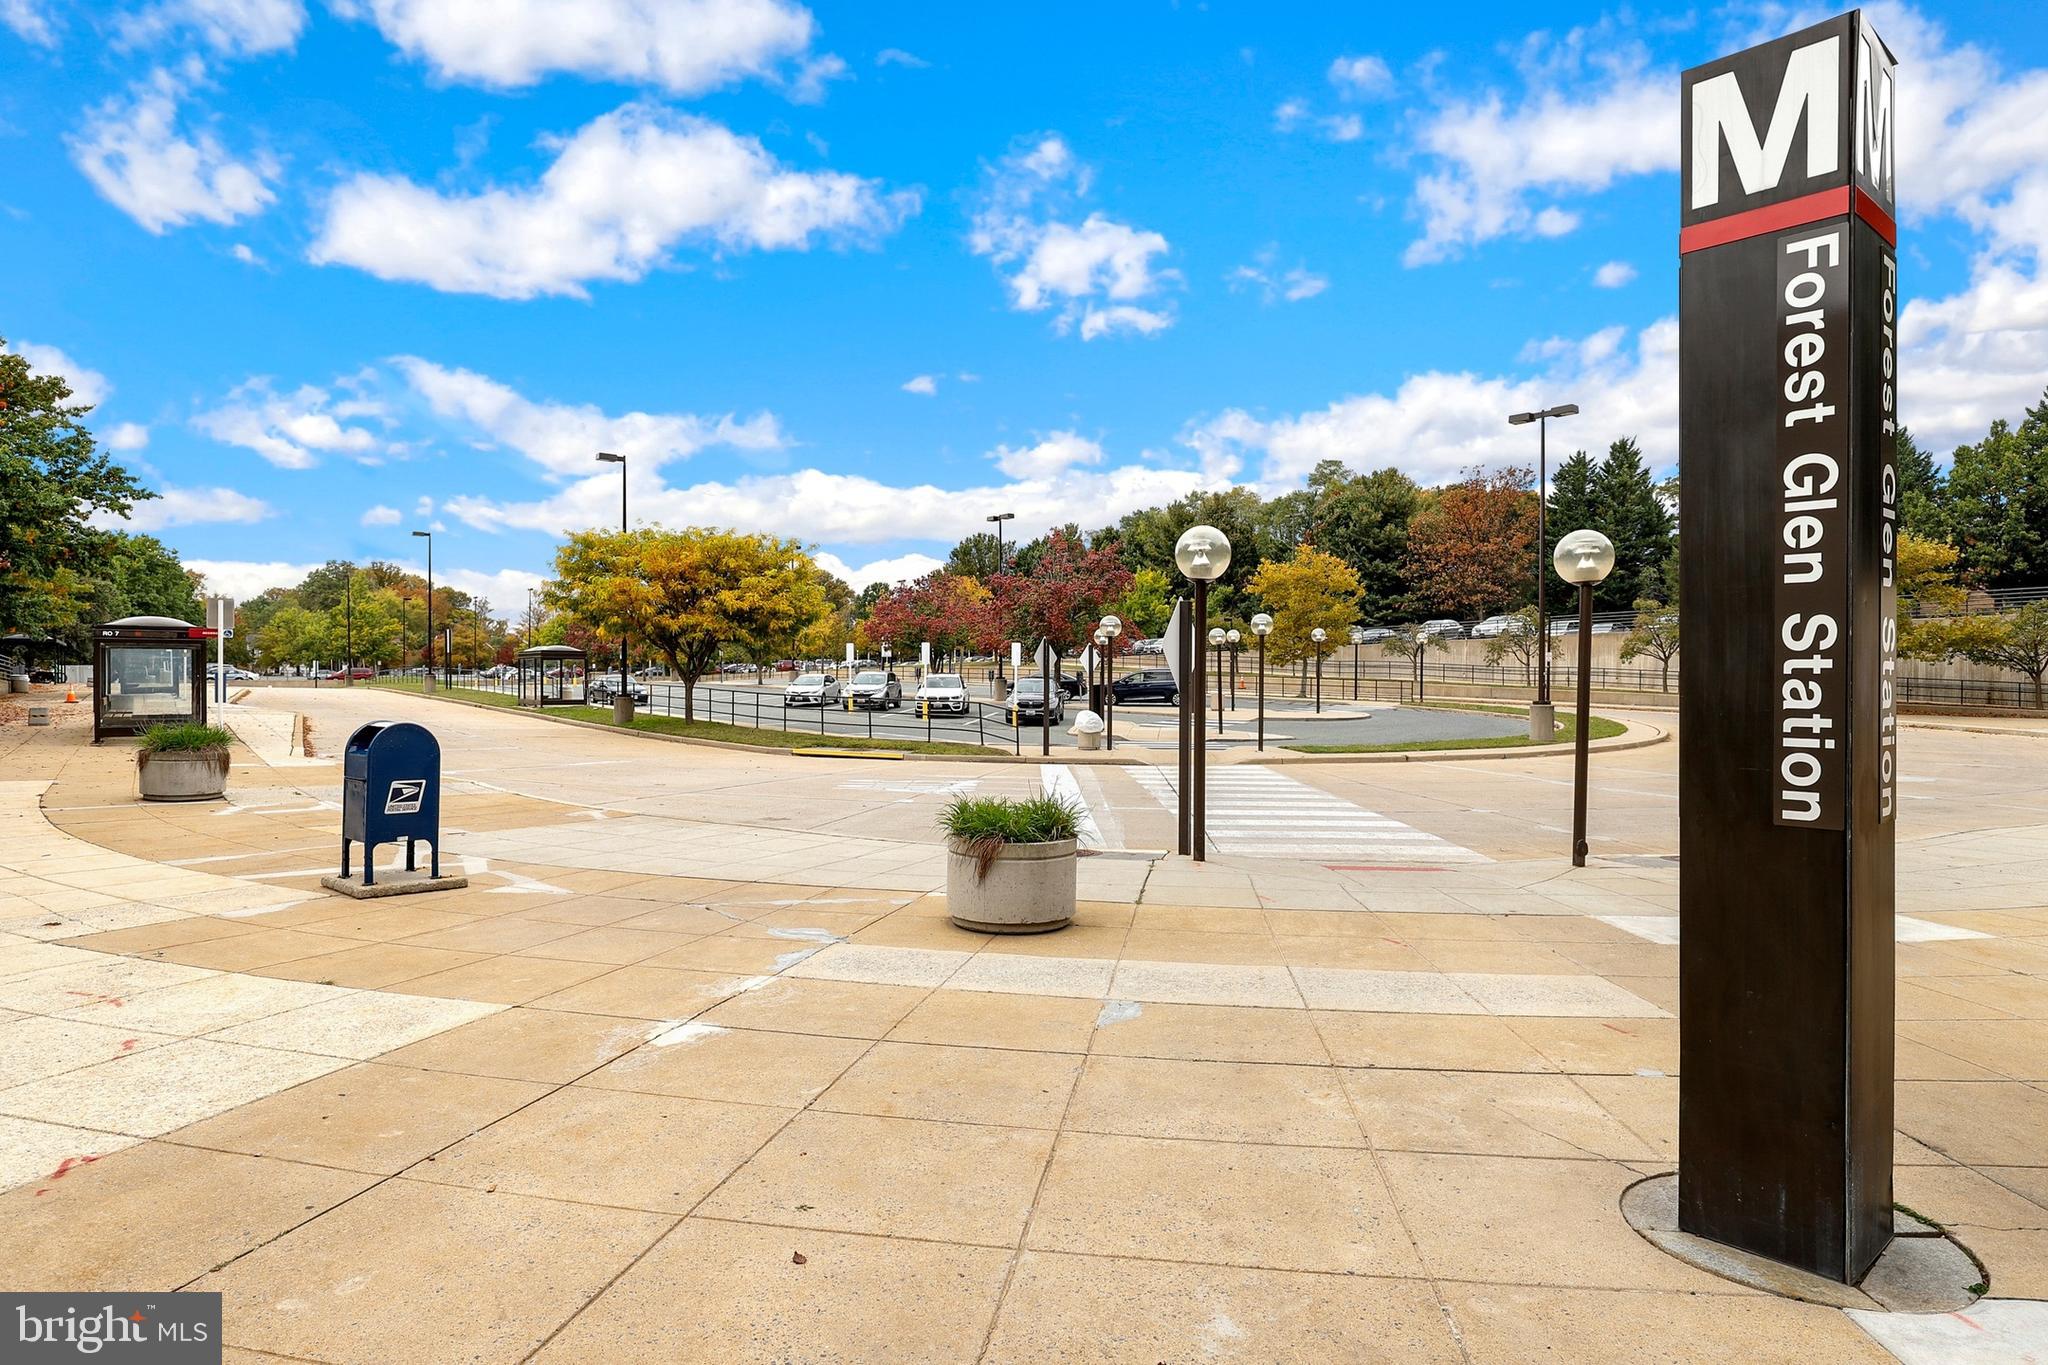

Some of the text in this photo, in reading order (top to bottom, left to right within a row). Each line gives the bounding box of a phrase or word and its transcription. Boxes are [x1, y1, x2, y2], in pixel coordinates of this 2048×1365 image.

[1692, 35, 1840, 210] M
[1856, 33, 1893, 204] M
[1781, 231, 1840, 822] Forest Glen Station
[1881, 253, 1896, 818] Forest Glen Station
